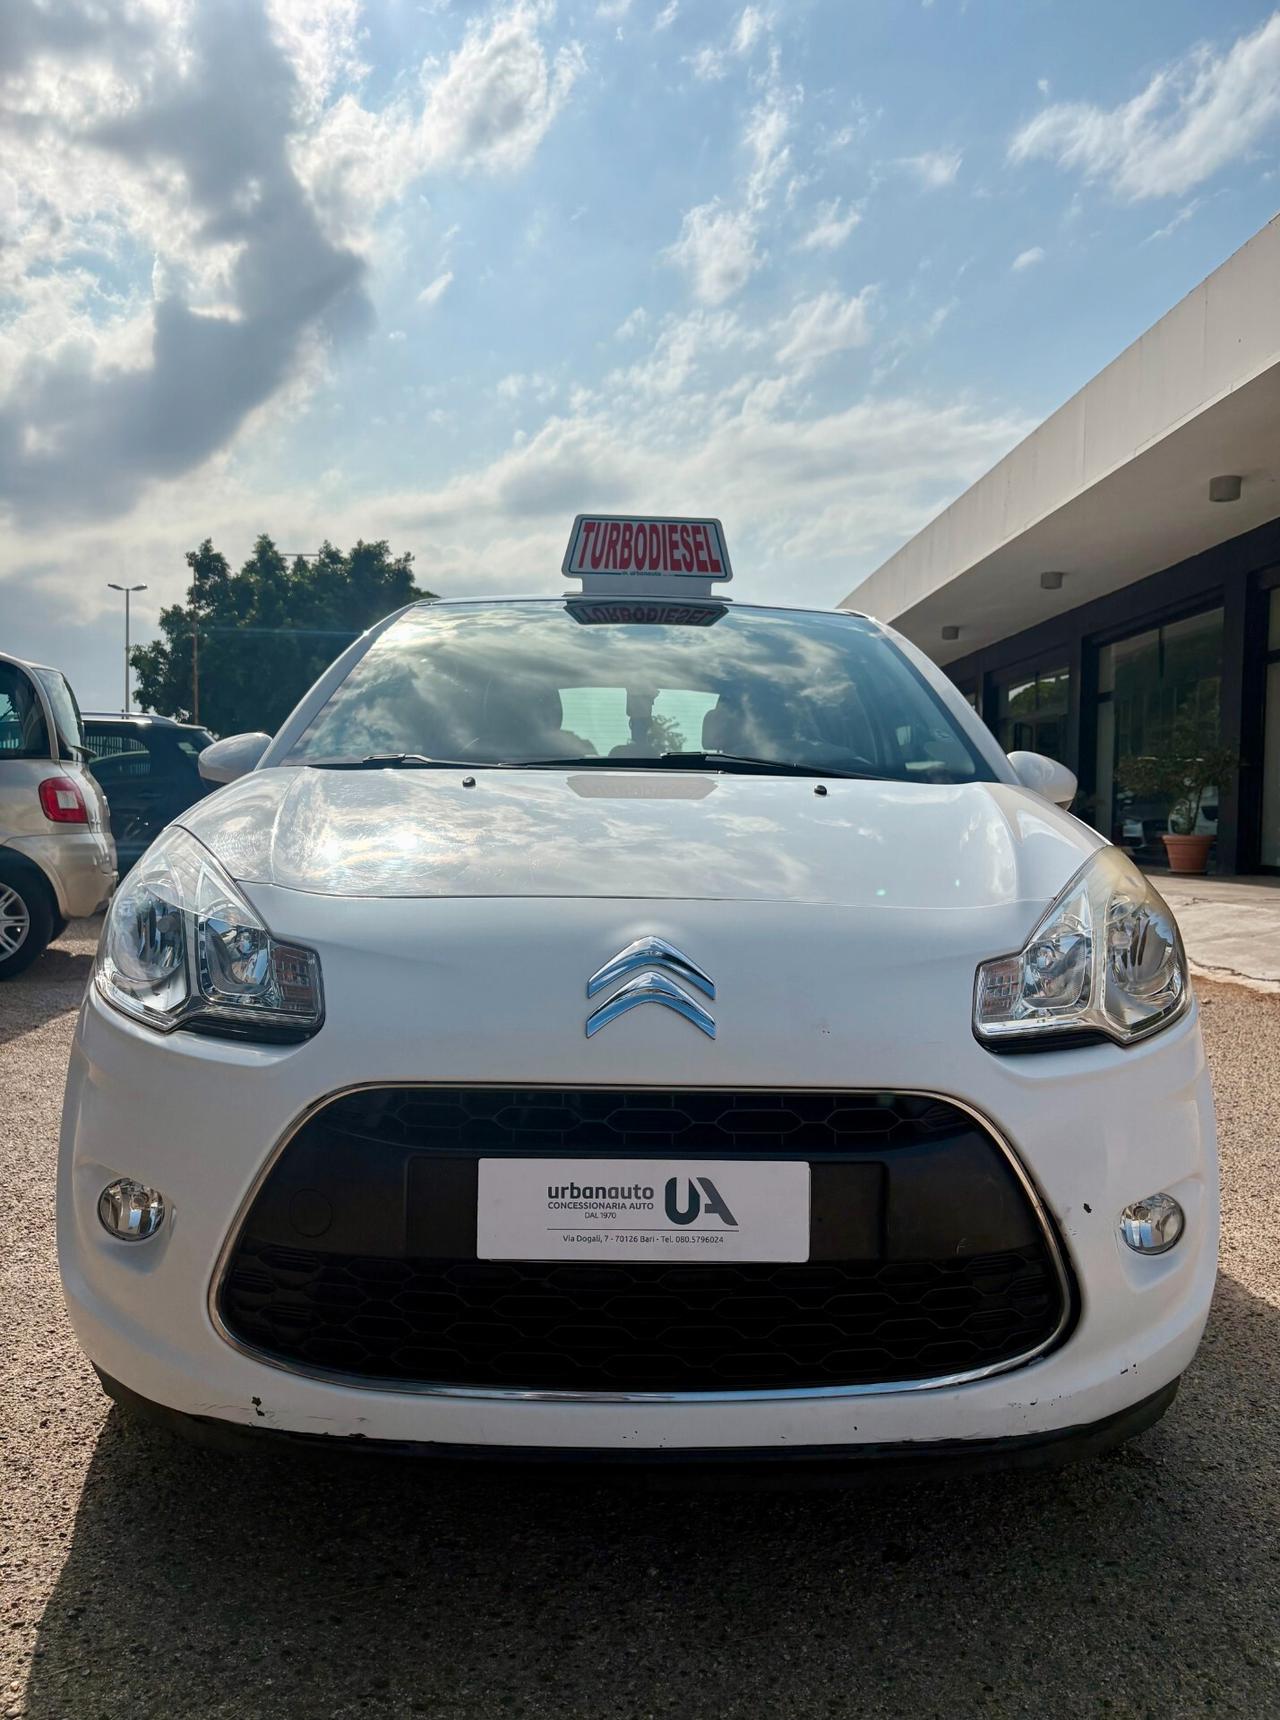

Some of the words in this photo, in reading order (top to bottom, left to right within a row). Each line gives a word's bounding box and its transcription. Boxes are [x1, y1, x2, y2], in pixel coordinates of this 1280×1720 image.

[578, 522, 722, 573] TURBODIESEL
[547, 1182, 655, 1200] urbanauto
[547, 1201, 627, 1211] CONCESSIONARIA
[628, 1202, 655, 1211] AUTO
[664, 1176, 739, 1226] UA
[584, 1211, 599, 1220] DAL
[600, 1211, 617, 1220] 1970
[562, 1234, 575, 1243] Via
[576, 1234, 603, 1245] Dogali,
[604, 1235, 609, 1243] 7
[615, 1235, 639, 1243] 70126
[640, 1235, 655, 1243] Bari
[661, 1235, 674, 1244] Tel.
[675, 1235, 724, 1244] 080.5796024
